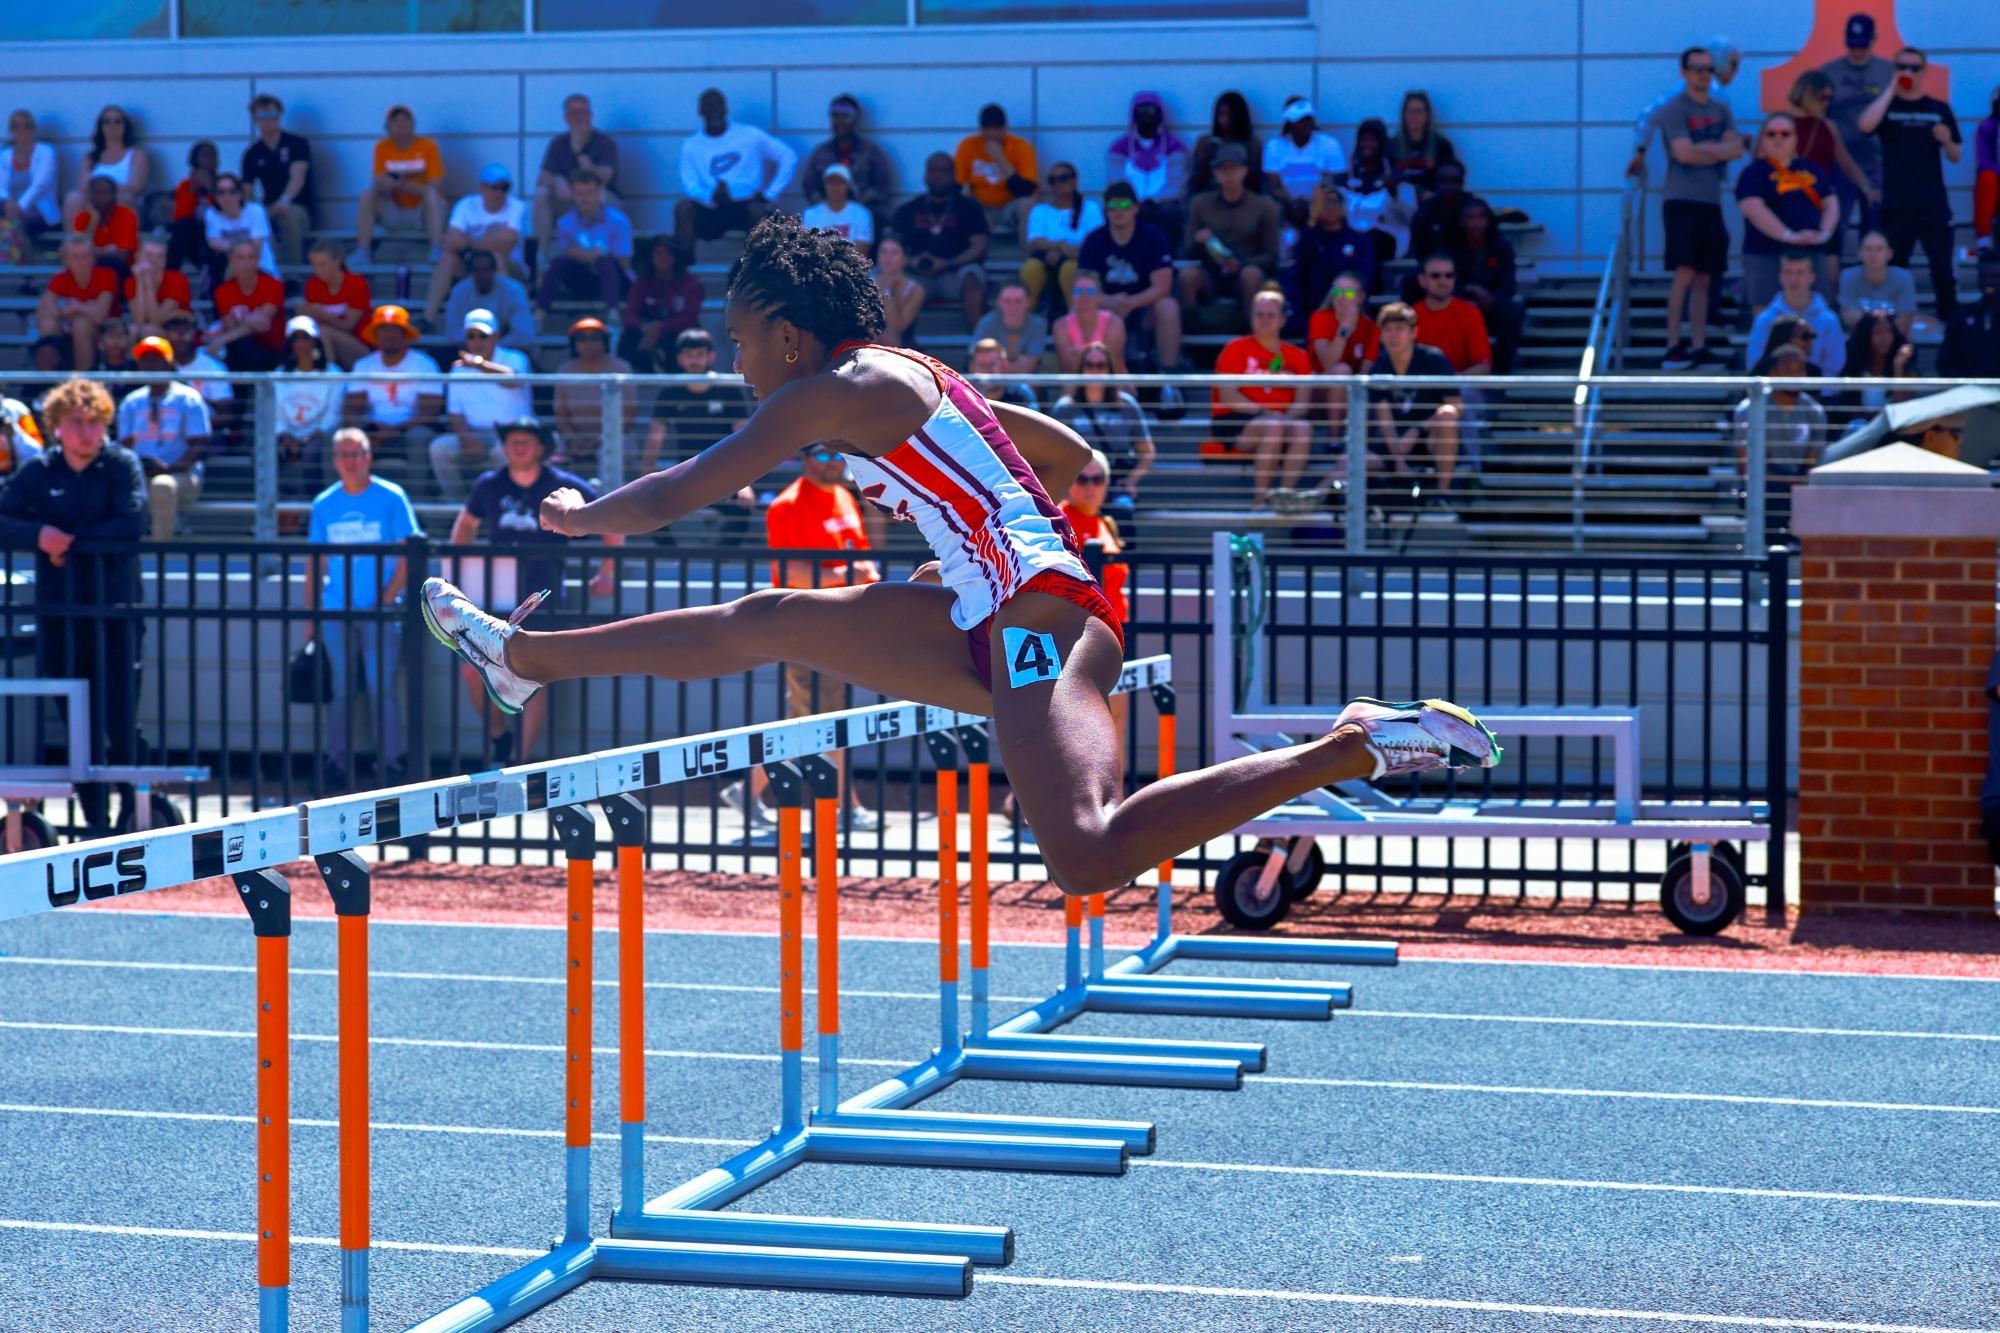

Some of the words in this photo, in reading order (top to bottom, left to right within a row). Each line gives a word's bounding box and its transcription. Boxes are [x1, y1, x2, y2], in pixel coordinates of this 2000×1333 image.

[1014, 634, 1054, 677] 4
[865, 711, 900, 742] UCS
[683, 740, 729, 778] UCS
[434, 781, 498, 828] UCS
[228, 840, 243, 853] IAAF
[46, 845, 147, 908] UCS
